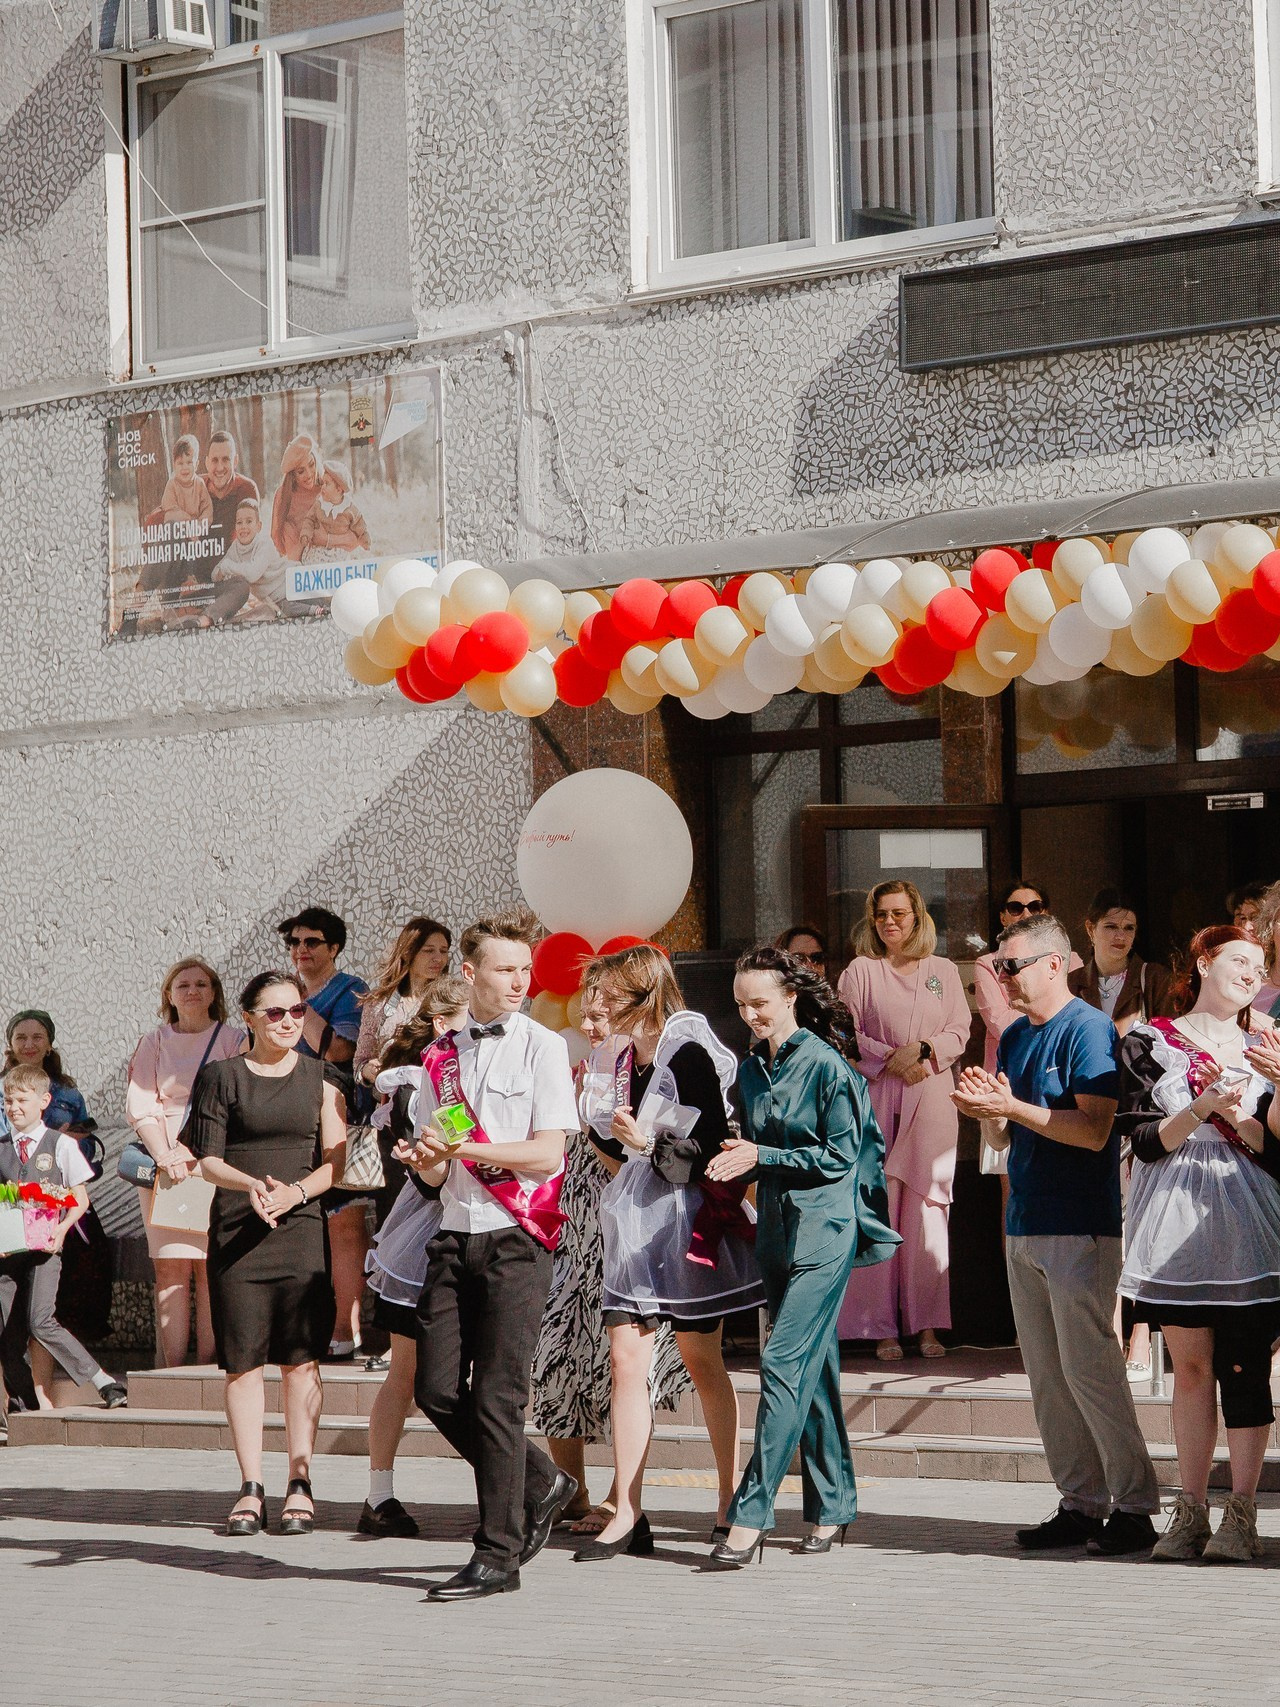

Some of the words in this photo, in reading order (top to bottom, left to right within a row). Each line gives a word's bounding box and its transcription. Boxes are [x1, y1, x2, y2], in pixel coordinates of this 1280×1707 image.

[118, 430, 141, 444] НОВ
[118, 443, 141, 456] РОС
[118, 453, 156, 469] СИЙСК
[120, 522, 171, 546] БОЛЬШАЯ
[173, 518, 209, 540] СЕМЬЯ
[120, 545, 172, 568] БОЛЬШАЯ
[173, 538, 225, 562] РАДОСТЬ!
[294, 567, 342, 593] ВАЖНО
[545, 828, 576, 848] путь!
